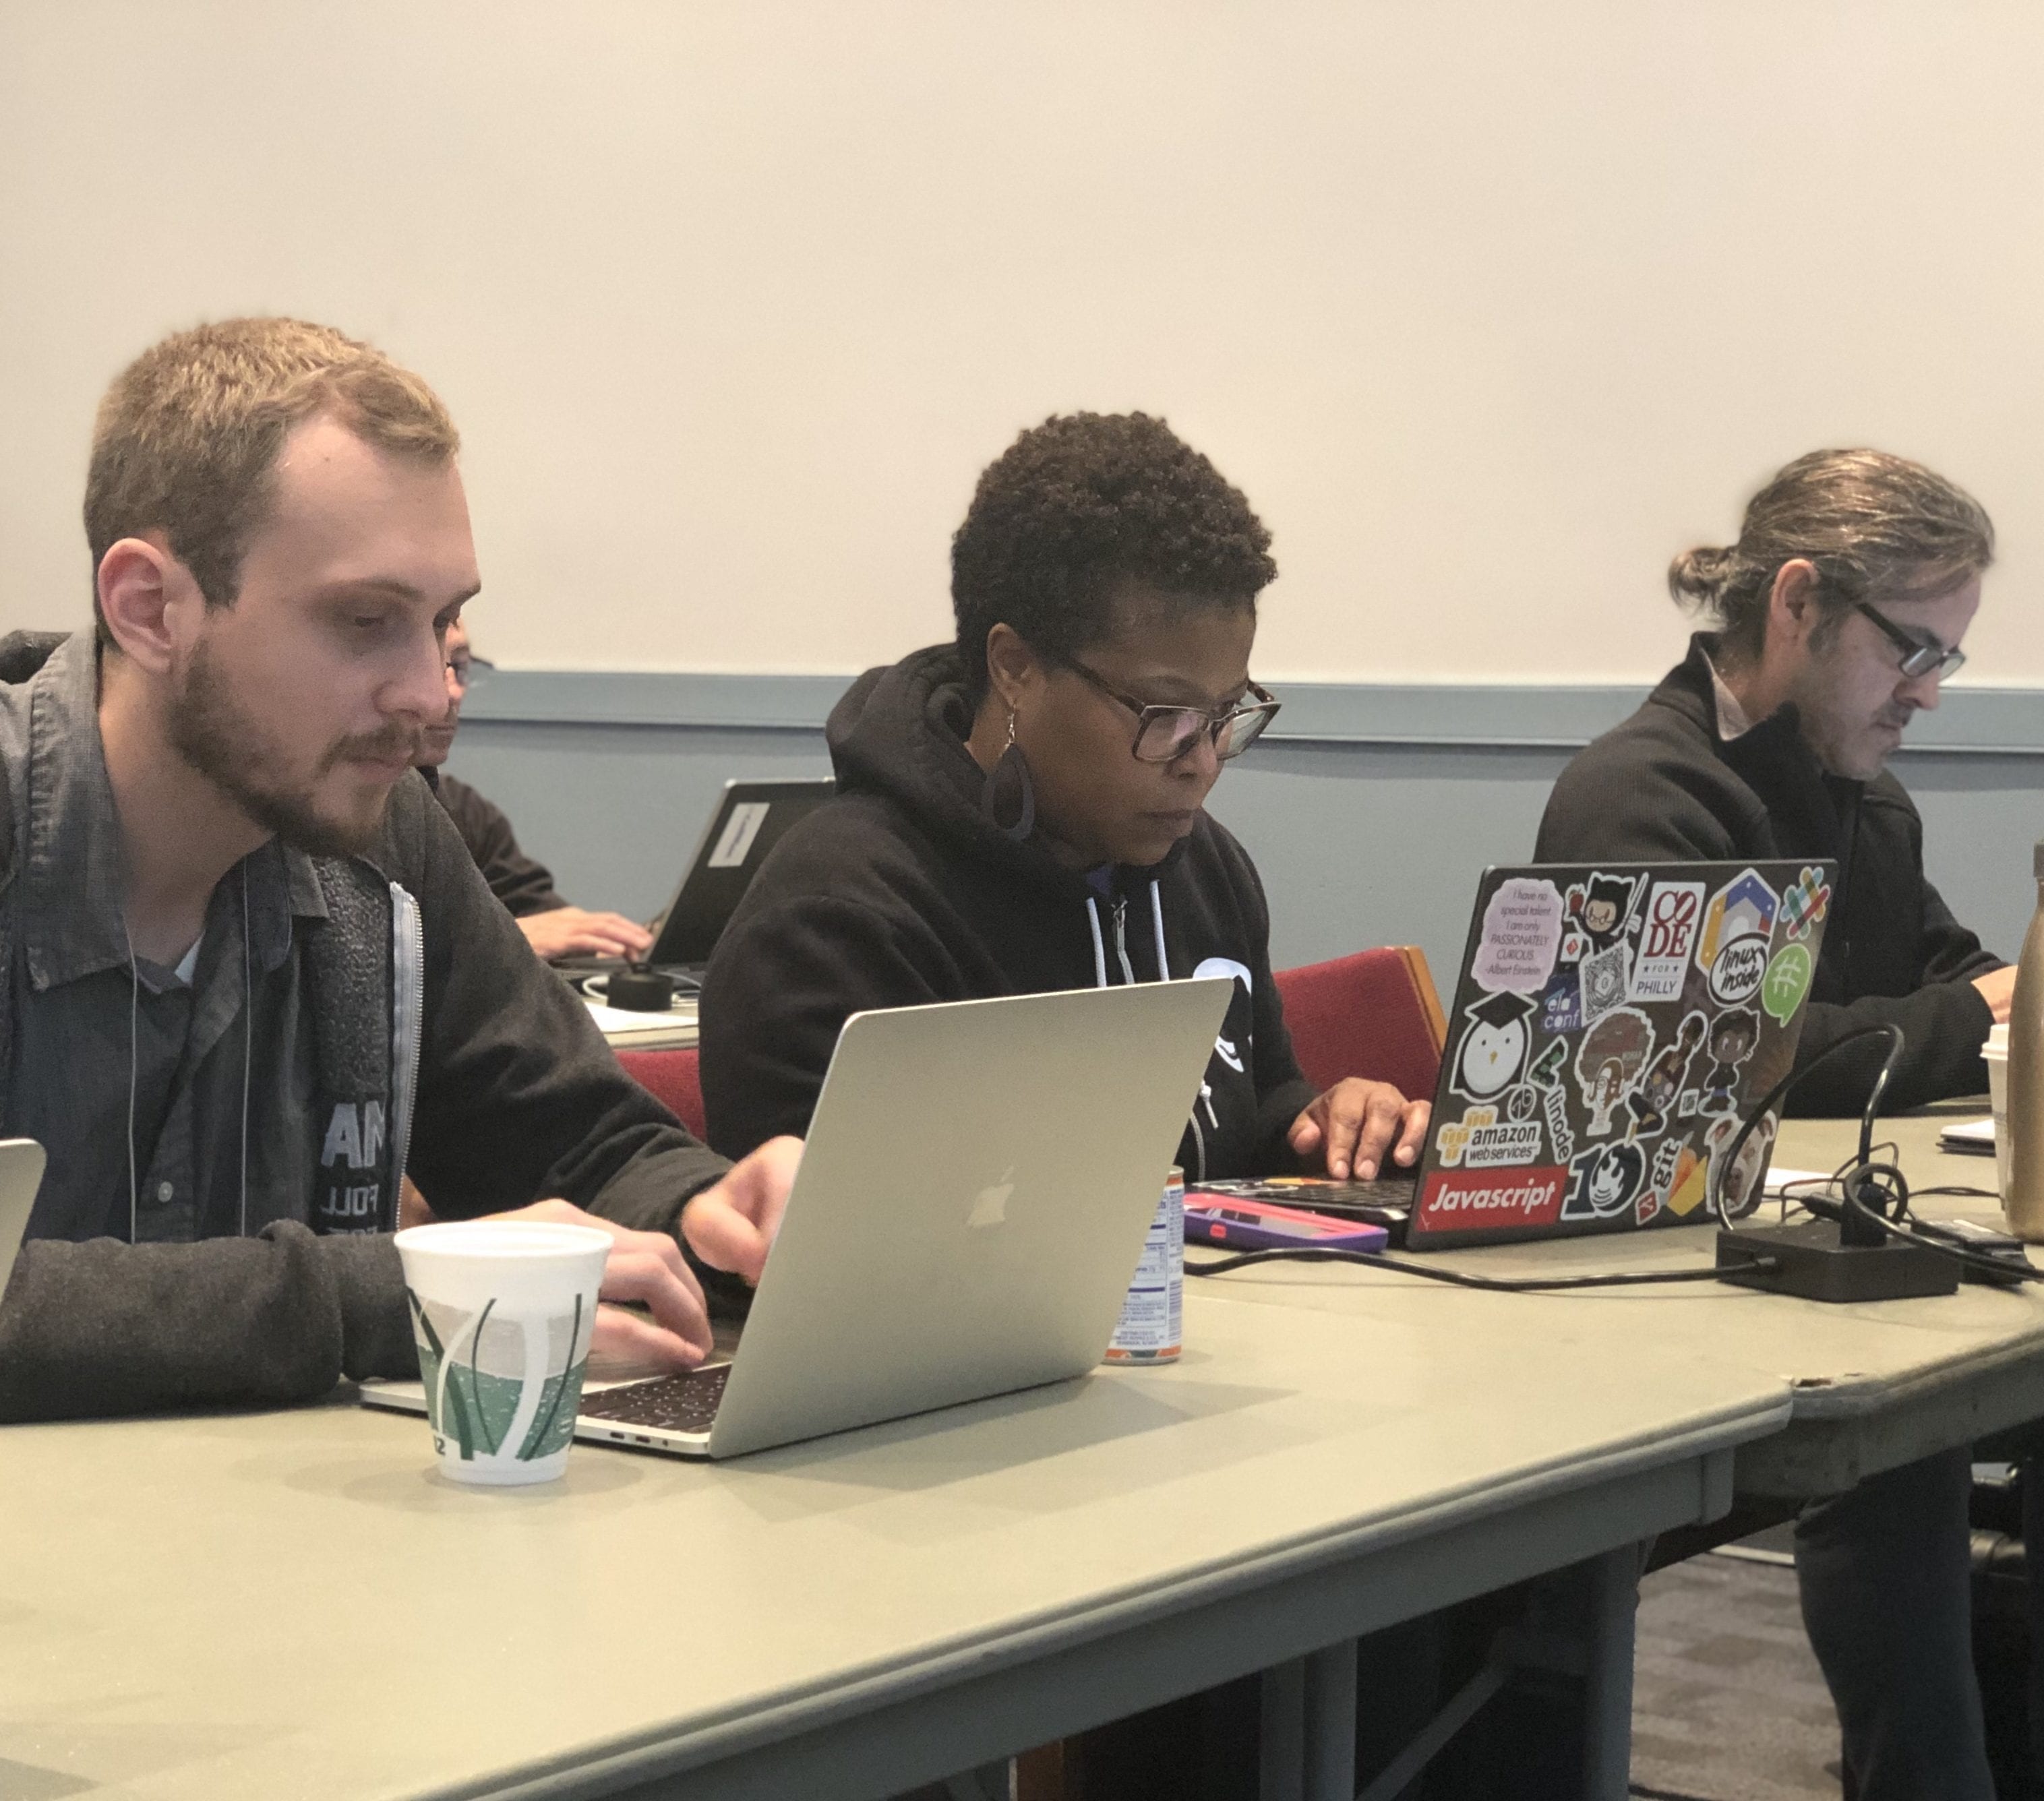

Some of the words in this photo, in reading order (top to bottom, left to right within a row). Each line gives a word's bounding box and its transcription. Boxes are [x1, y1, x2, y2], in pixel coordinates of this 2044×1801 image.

[1517, 888, 1536, 900] have
[1538, 892, 1548, 901] no
[1490, 934, 1550, 946] PASSIONATELY
[1497, 948, 1535, 960] CURIOUS
[1513, 963, 1542, 975] Einstein
[1652, 965, 1670, 973] FOR
[1720, 965, 1760, 992] inside
[1635, 980, 1678, 995] PHILLY
[1544, 1008, 1580, 1029] conf
[1547, 1089, 1571, 1161] linode
[1471, 1125, 1537, 1146] amazon
[1429, 1178, 1556, 1215] Javascript
